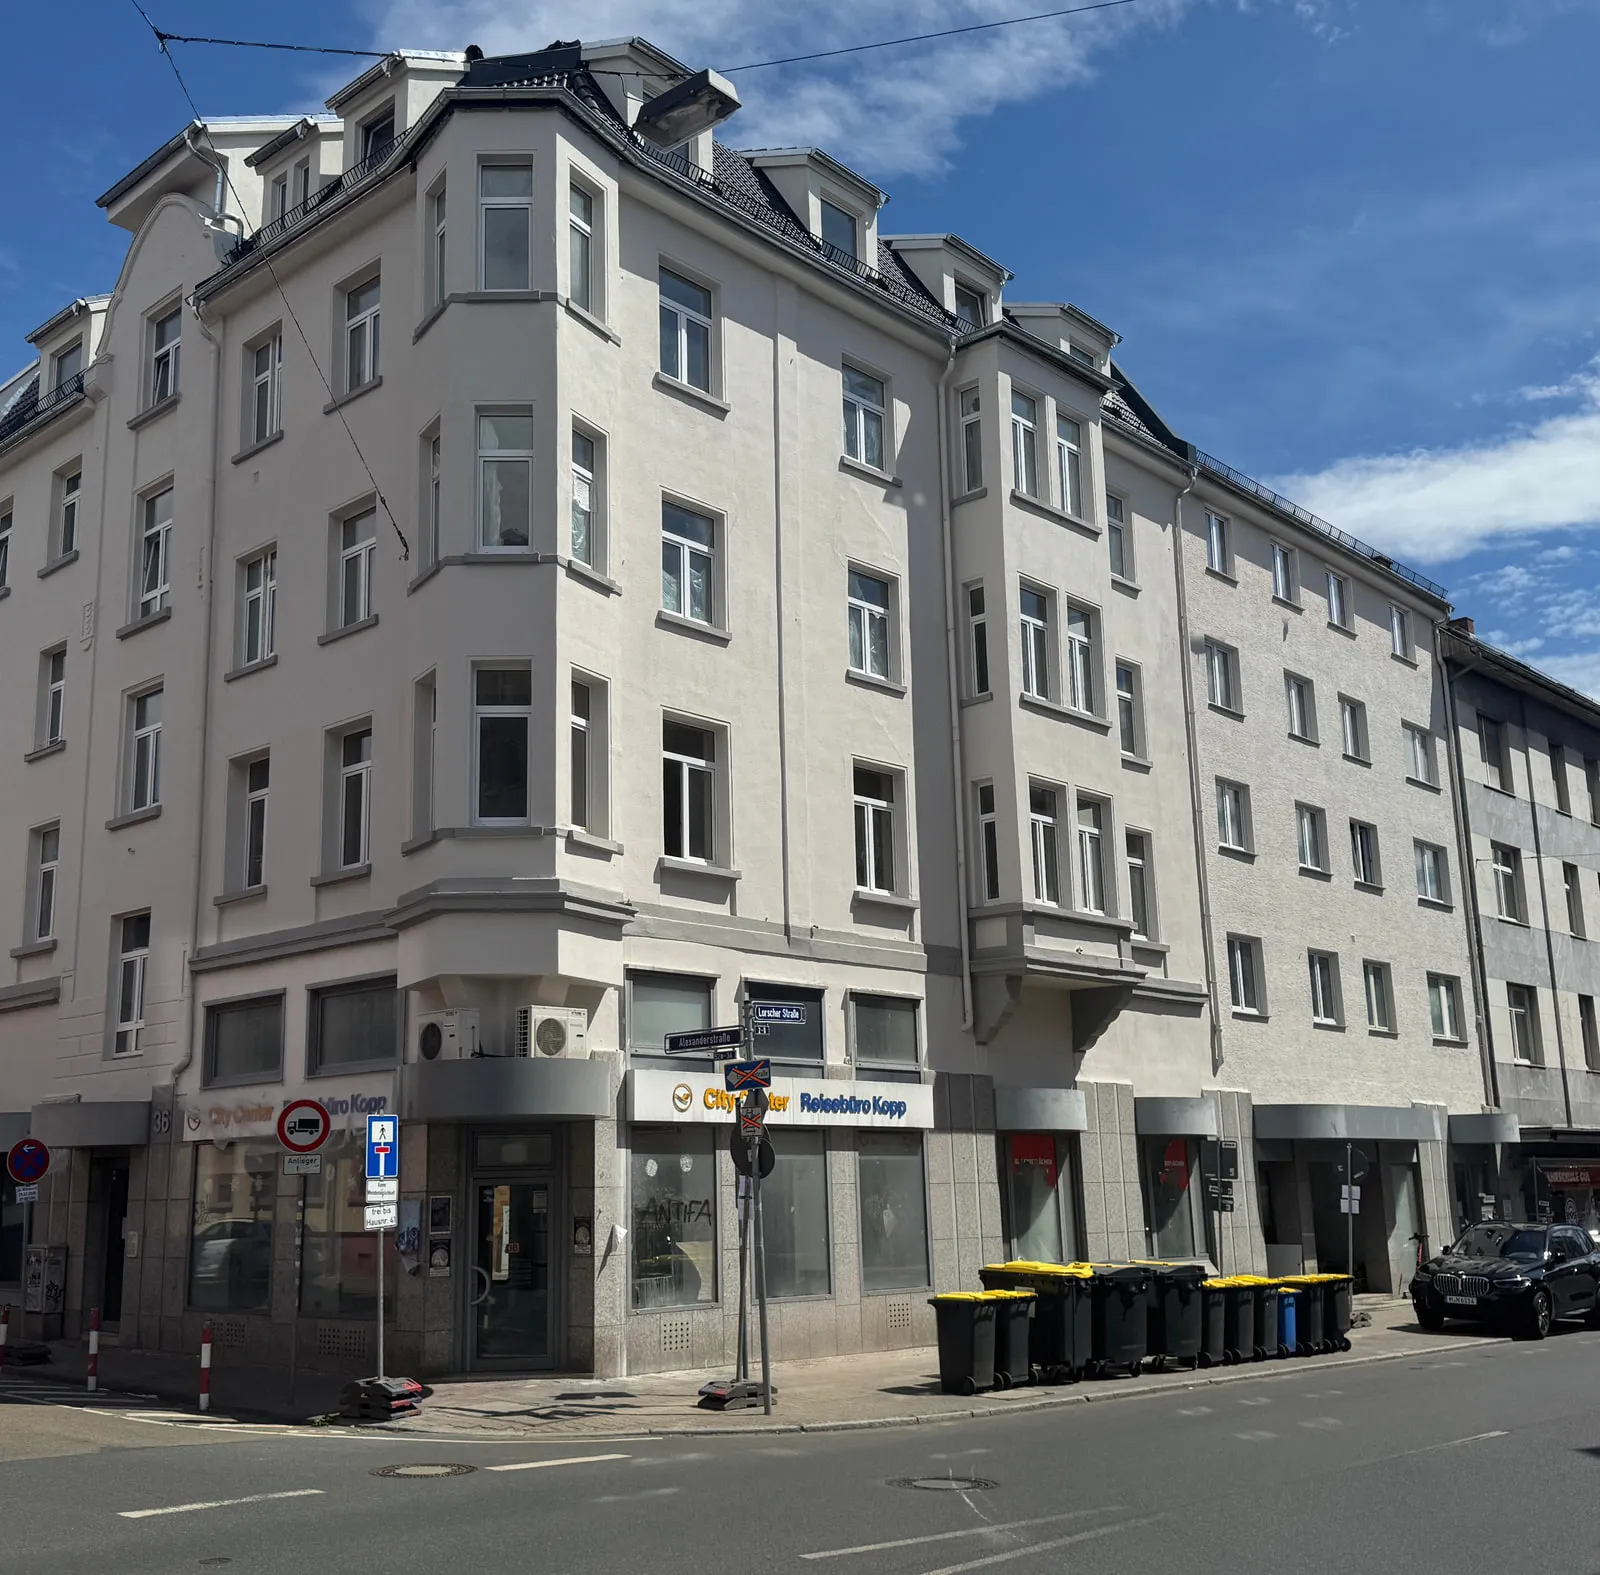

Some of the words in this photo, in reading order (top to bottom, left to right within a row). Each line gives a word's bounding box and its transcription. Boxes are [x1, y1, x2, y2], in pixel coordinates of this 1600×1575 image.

[758, 1007, 781, 1018] Lorscher
[782, 1008, 800, 1019] Straße
[679, 1032, 731, 1047] Alexanderstraße
[800, 1092, 871, 1114] Reisebüro
[872, 1095, 907, 1119] Kopp
[154, 1110, 170, 1134] 36
[640, 1197, 712, 1227] ANTIFA
